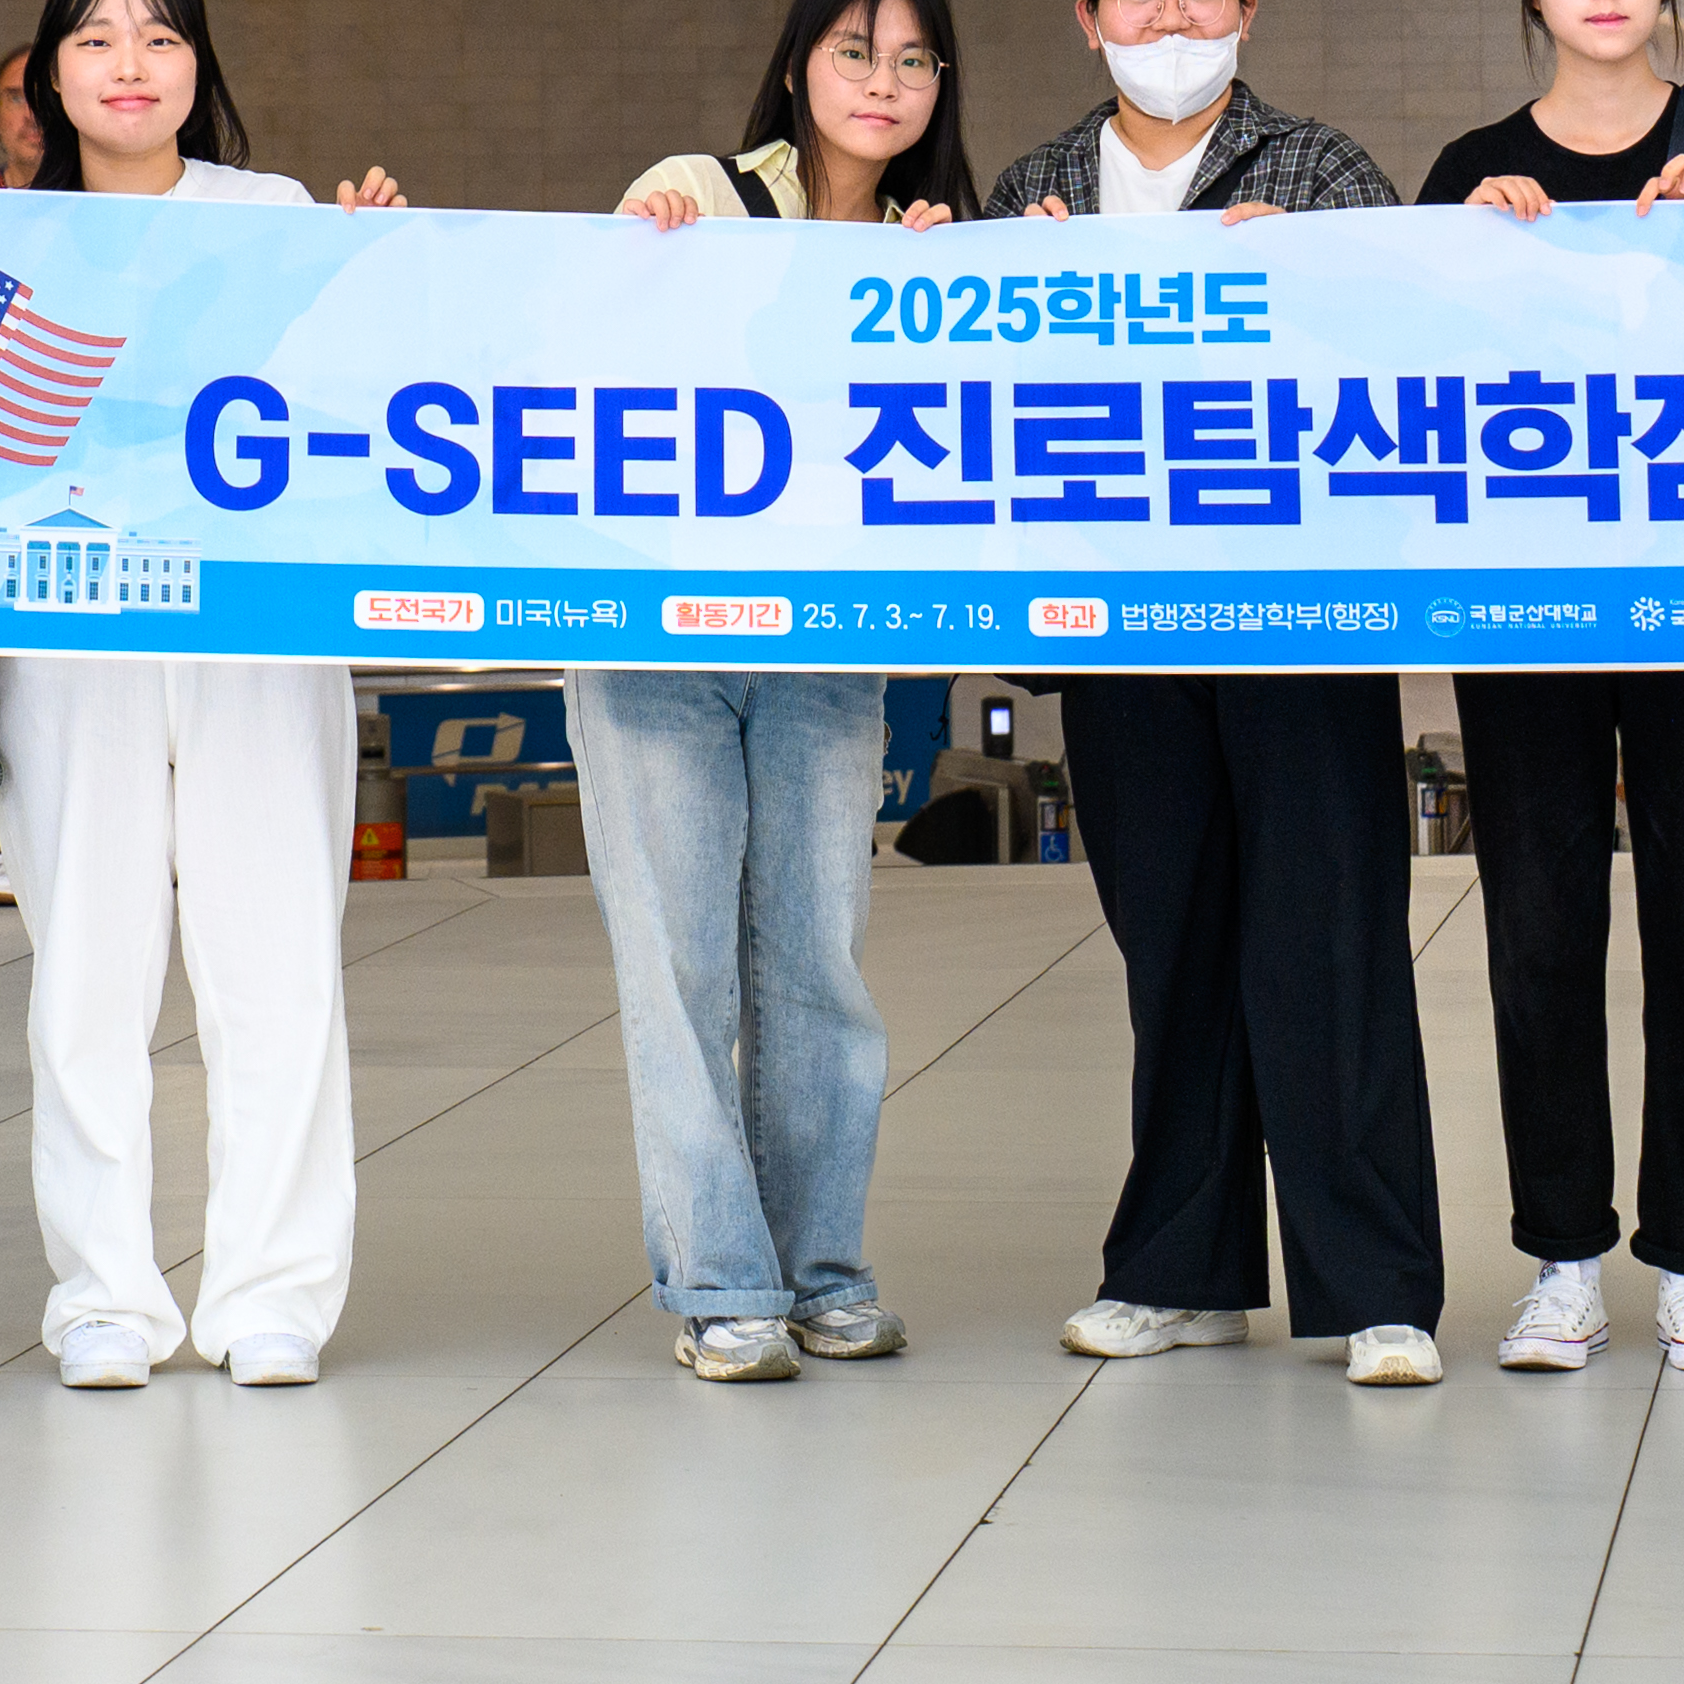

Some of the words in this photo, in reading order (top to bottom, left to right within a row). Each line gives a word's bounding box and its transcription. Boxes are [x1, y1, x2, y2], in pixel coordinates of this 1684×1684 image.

[848, 269, 1272, 347] 2025학년도
[184, 375, 793, 518] G-SEED
[368, 597, 474, 624] 도전국가
[496, 599, 627, 629] 미국(뉴욕)
[675, 601, 782, 629] 활동기간
[803, 603, 843, 630] 25.
[852, 603, 875, 630] 7.
[932, 604, 955, 631] 7.
[965, 604, 1001, 631] 19.
[1041, 603, 1097, 630] 학과
[1121, 601, 1399, 632] 법행정경찰학부(행정)
[1432, 610, 1460, 623] KSNU
[1469, 603, 1597, 622] 국립군산대학교
